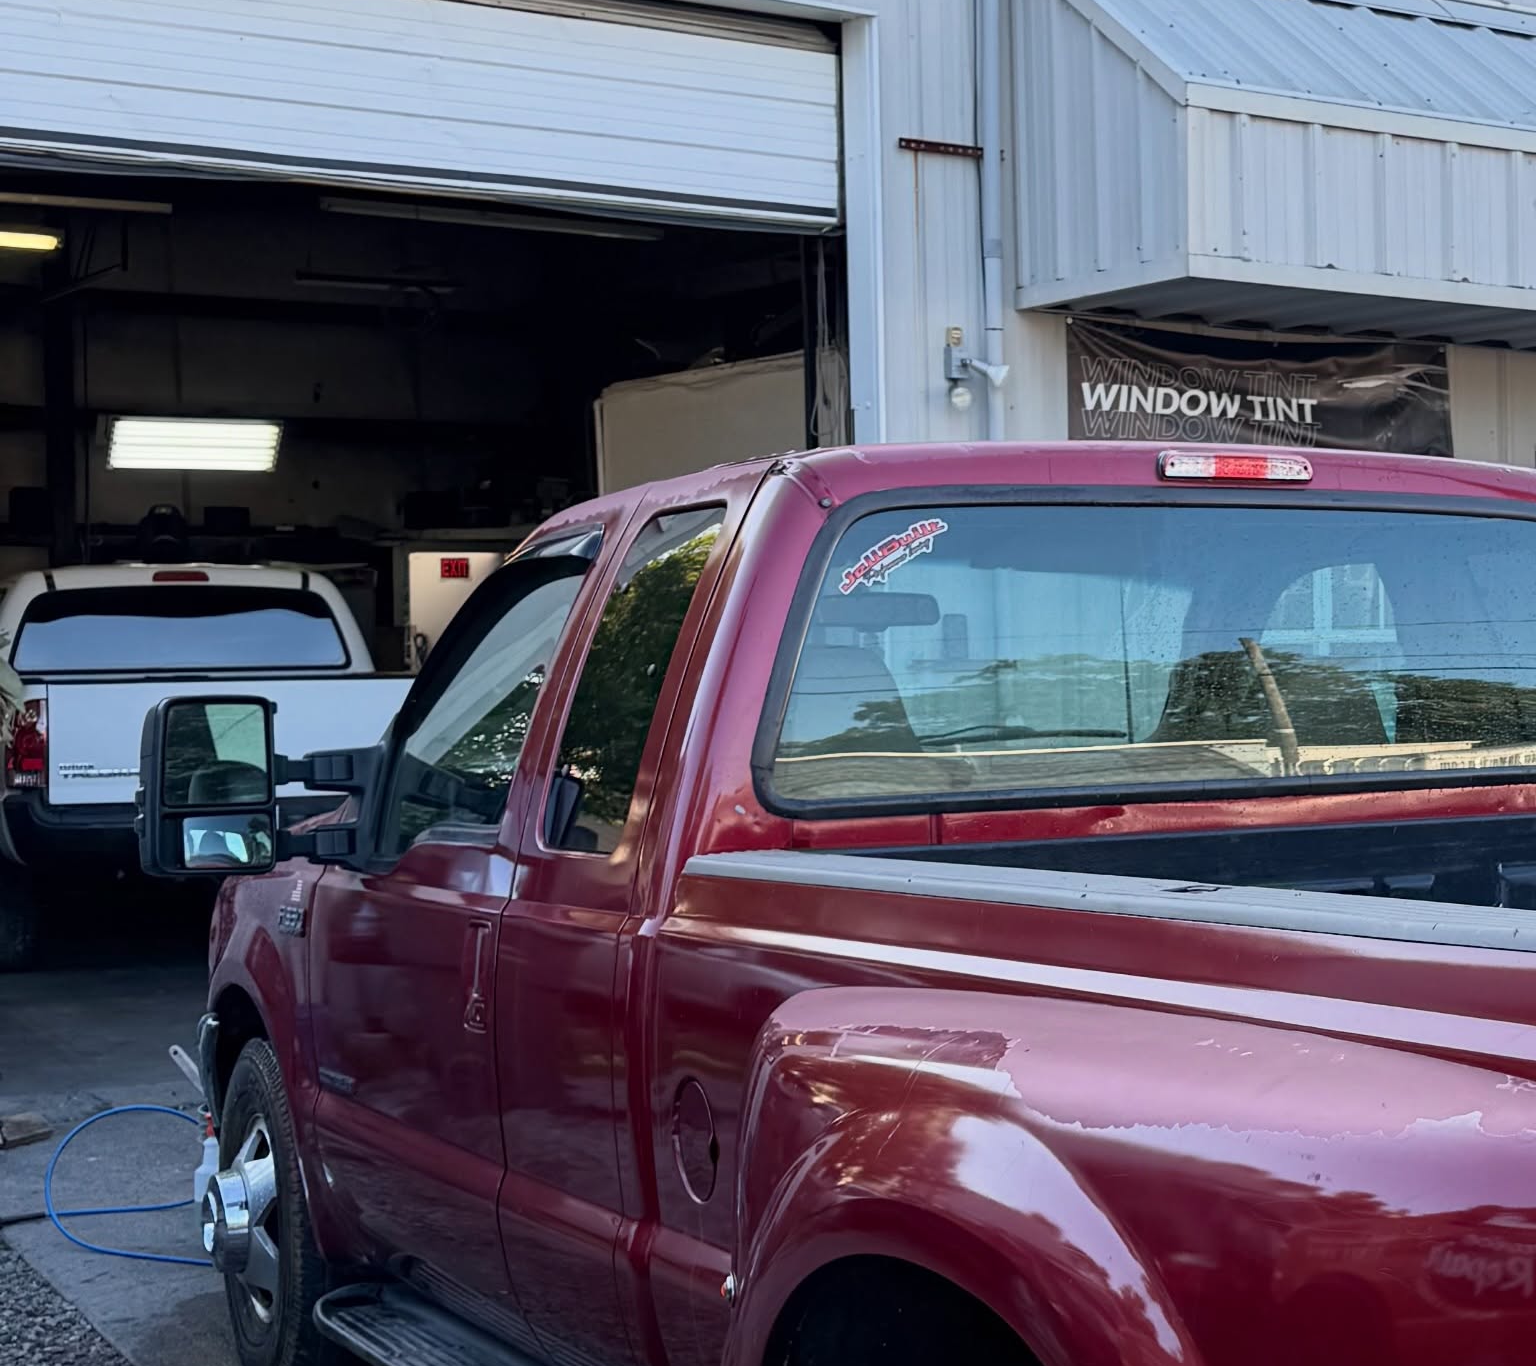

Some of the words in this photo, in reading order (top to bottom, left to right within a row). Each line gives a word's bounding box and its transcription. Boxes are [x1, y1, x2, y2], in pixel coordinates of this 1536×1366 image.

[1080, 355, 1241, 395] WINDOW
[1243, 370, 1317, 401] TINT
[1081, 382, 1241, 419] WINDOW
[1246, 395, 1318, 424] TINT
[1081, 408, 1246, 444] WINDOW
[1249, 421, 1322, 448] TINT
[442, 560, 468, 576] EXIT
